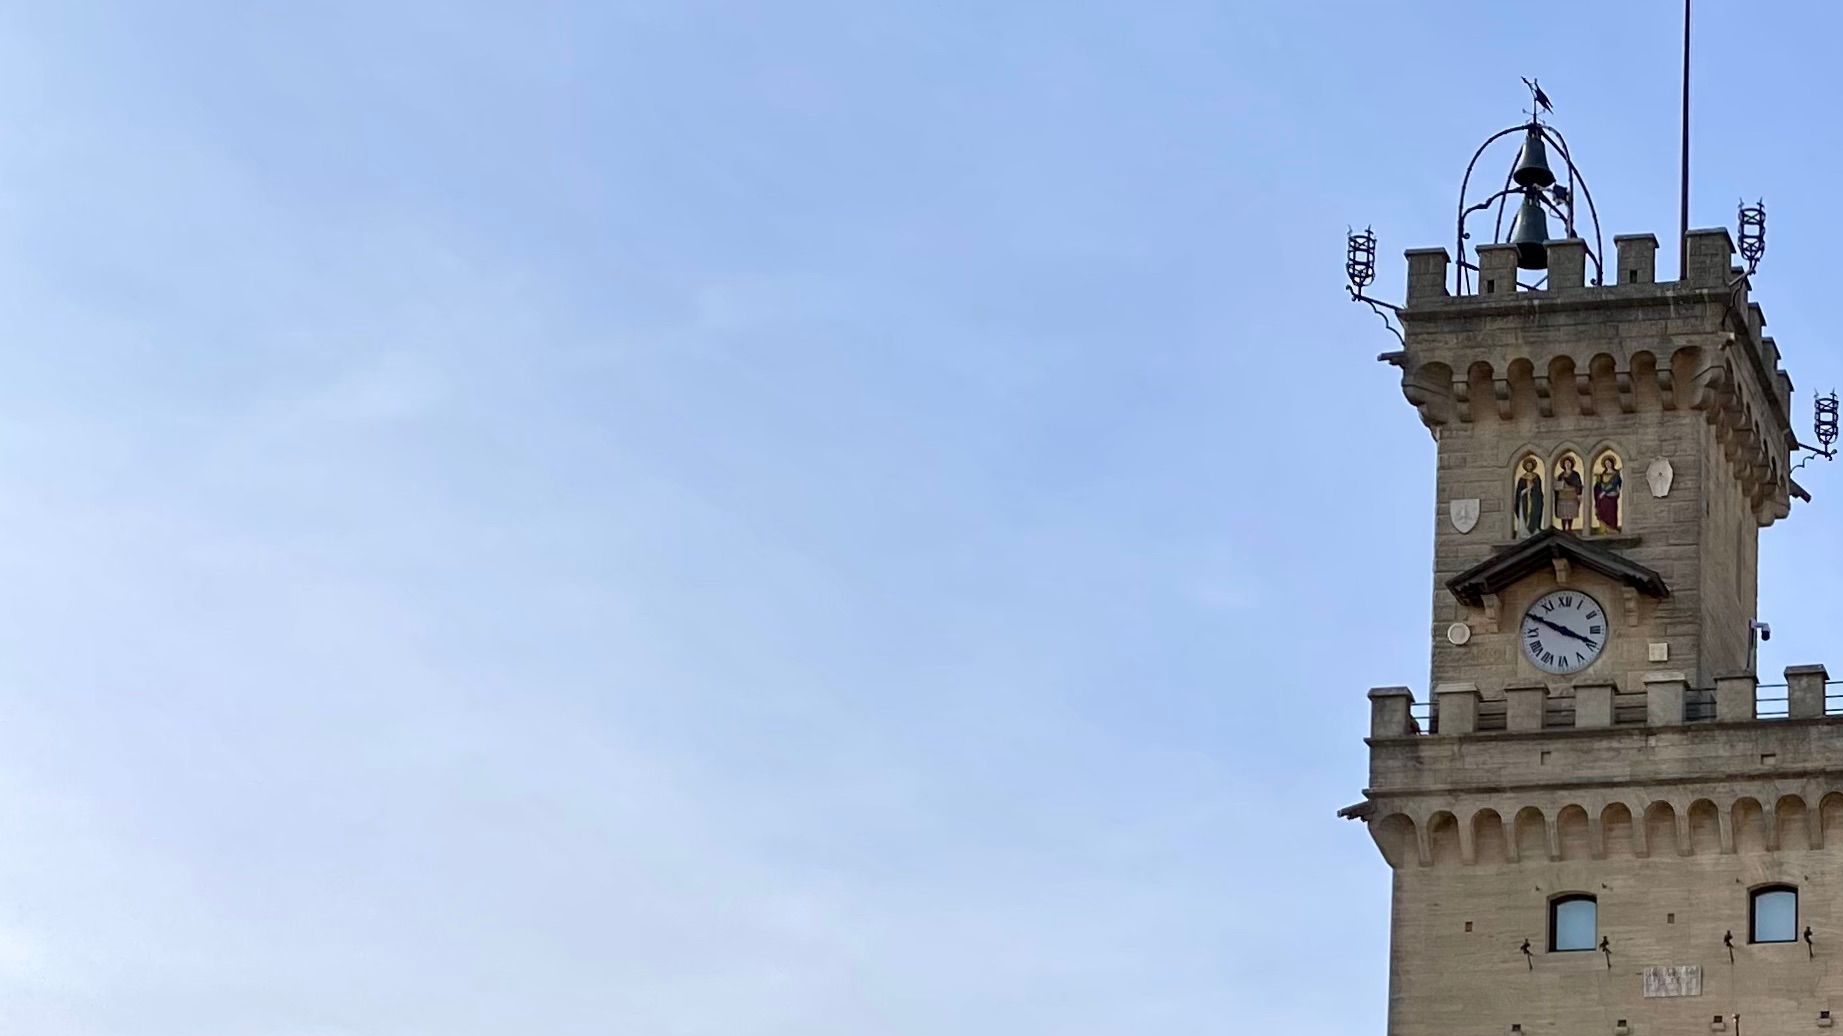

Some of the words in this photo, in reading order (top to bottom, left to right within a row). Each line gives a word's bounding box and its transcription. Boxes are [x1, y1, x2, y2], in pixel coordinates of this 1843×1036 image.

[1542, 600, 1555, 614] XI
[1558, 596, 1572, 607] XII
[1585, 610, 1597, 620] II
[1590, 625, 1601, 635] III
[1541, 652, 1554, 665] VII
[1558, 655, 1569, 667] VI
